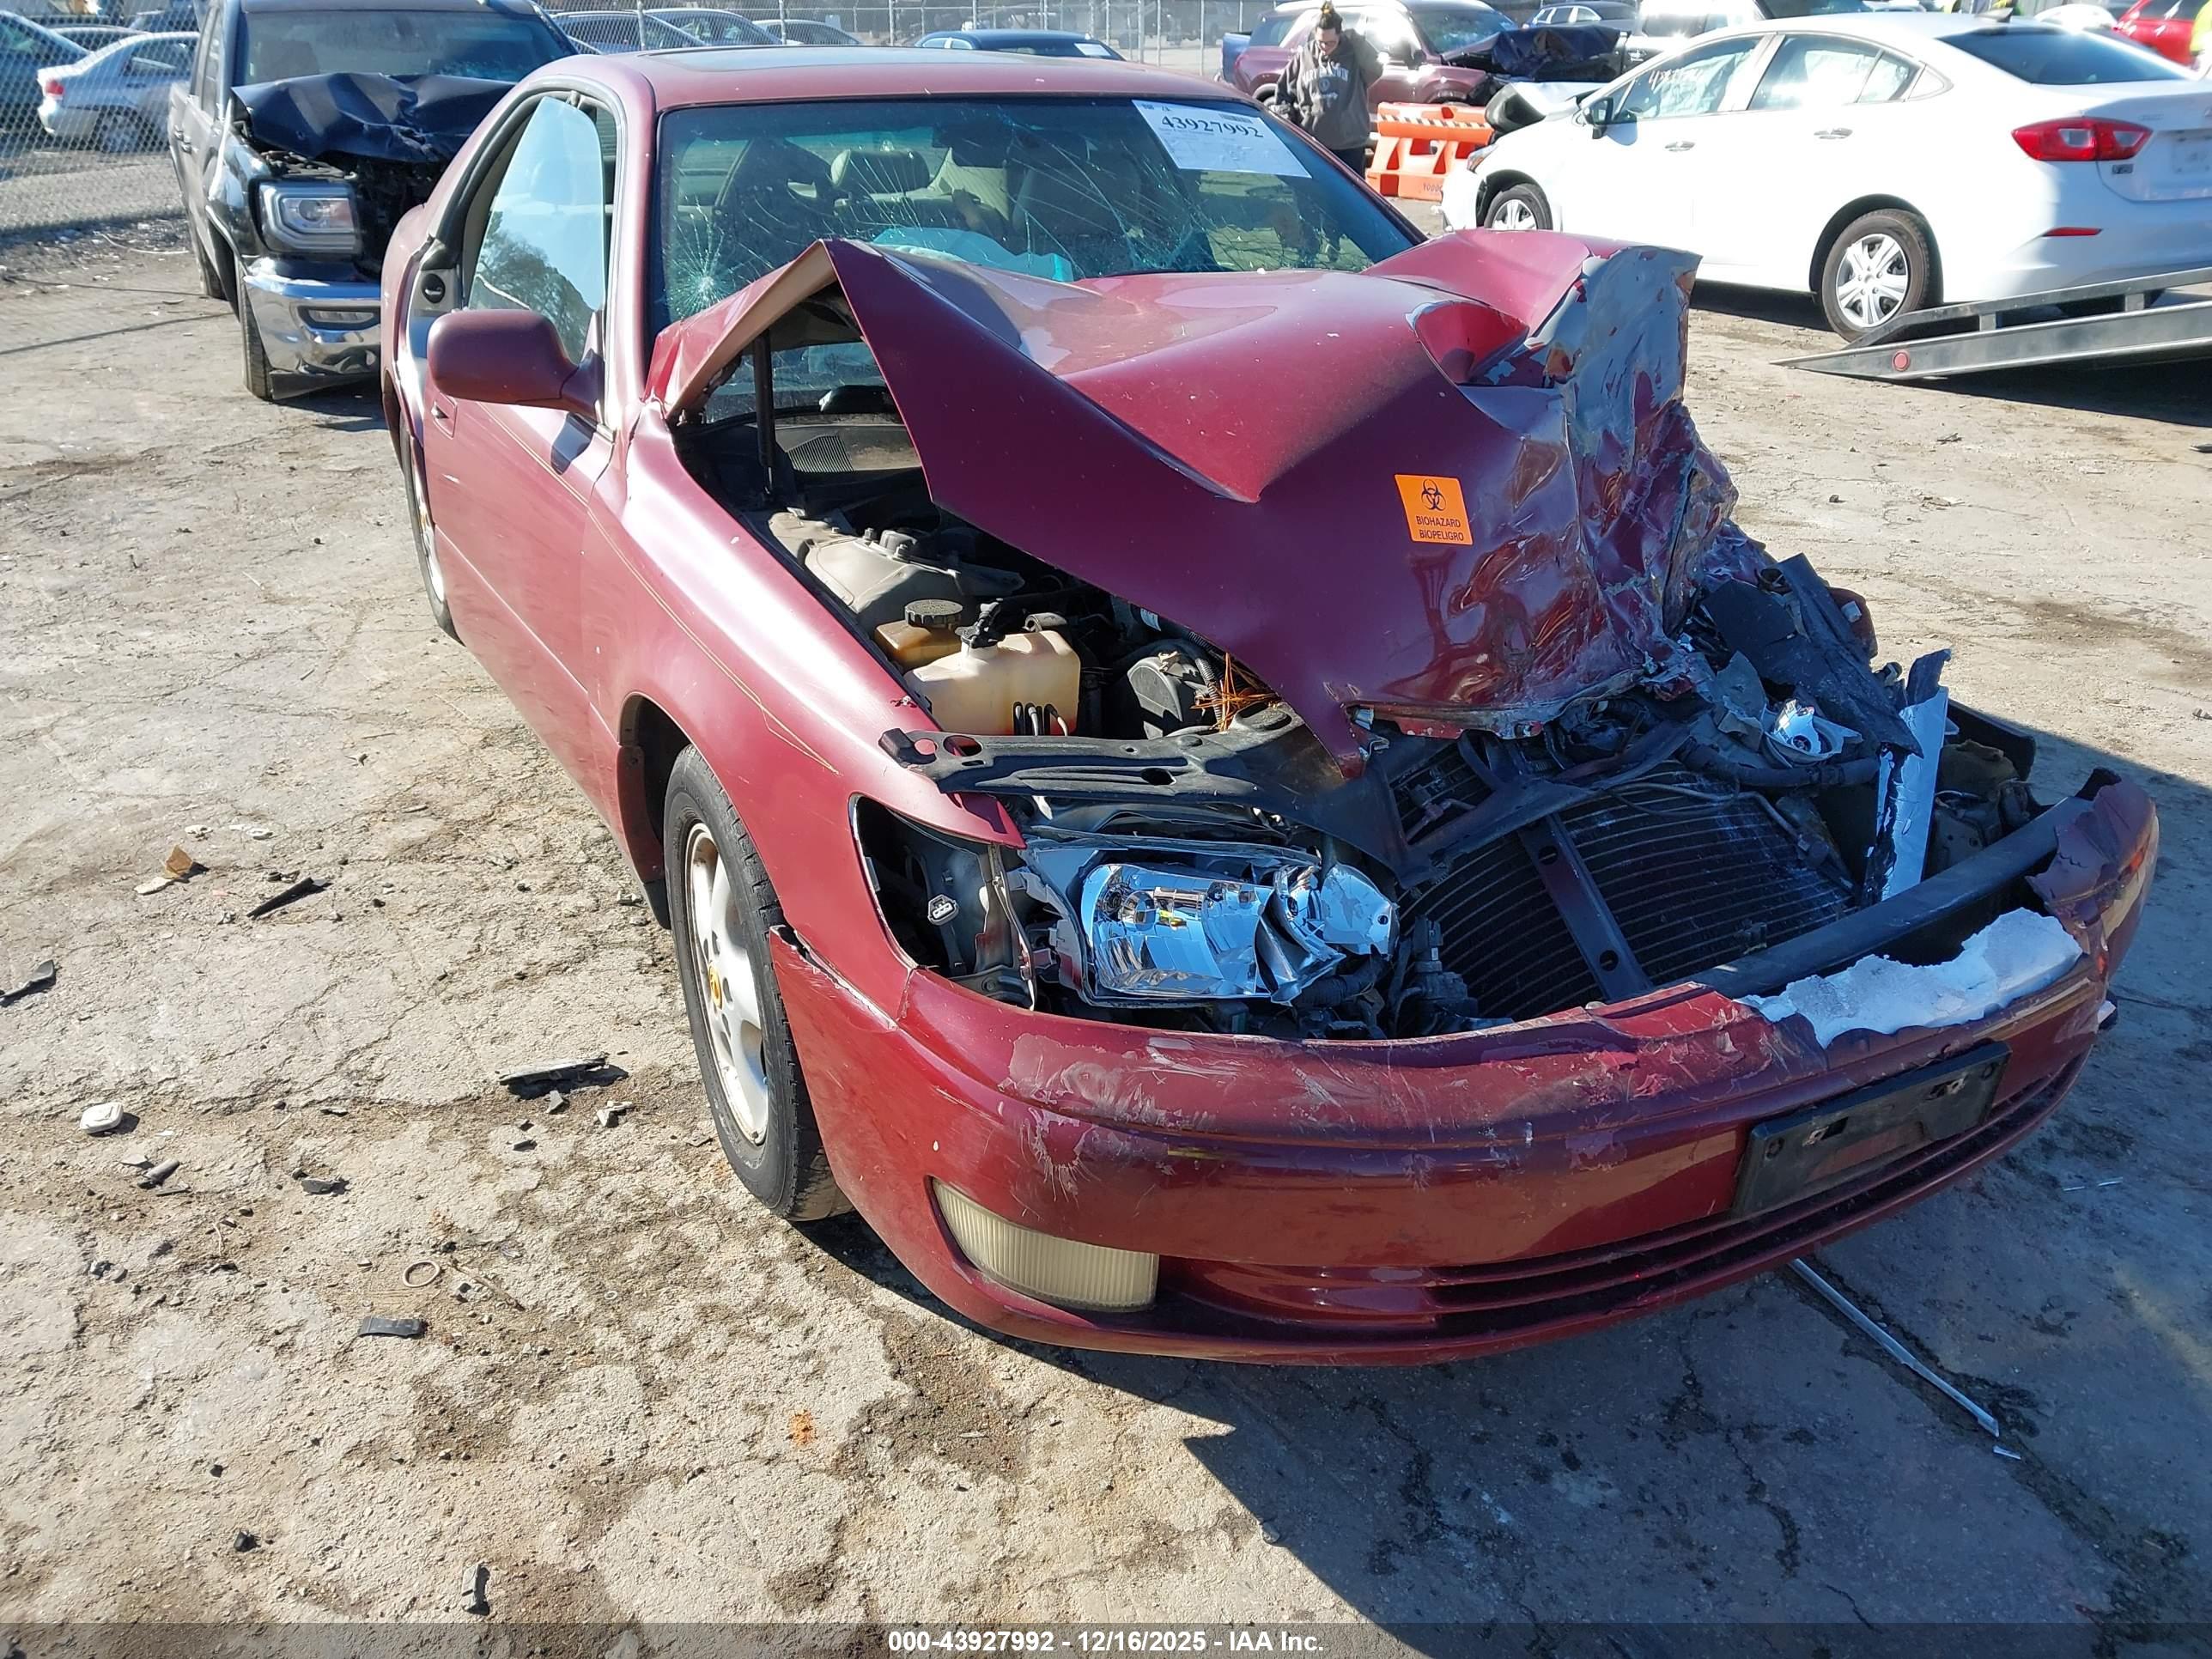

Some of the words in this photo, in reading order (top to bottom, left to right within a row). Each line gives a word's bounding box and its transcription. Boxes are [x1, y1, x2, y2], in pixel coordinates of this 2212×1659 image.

[1161, 115, 1264, 138] 43927992
[1415, 515, 1462, 528] BIOHAZARD
[1419, 529, 1464, 542] BIOPELIGRO
